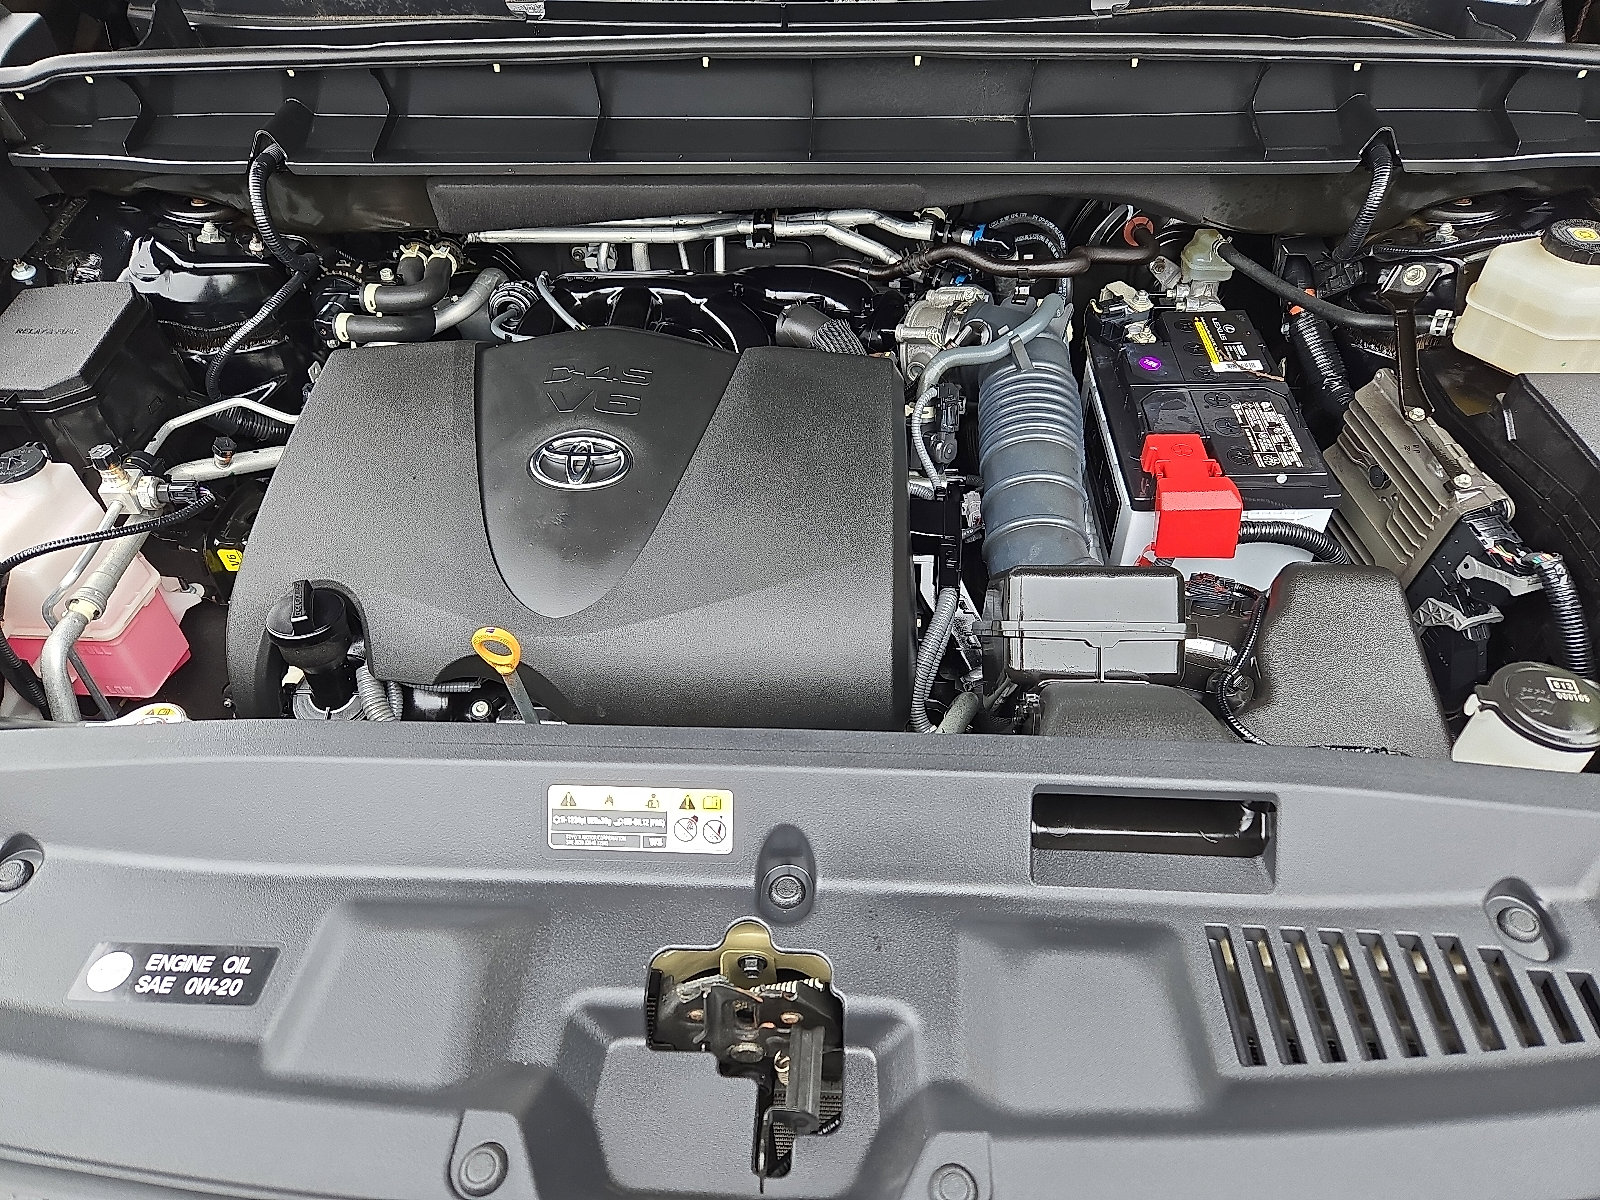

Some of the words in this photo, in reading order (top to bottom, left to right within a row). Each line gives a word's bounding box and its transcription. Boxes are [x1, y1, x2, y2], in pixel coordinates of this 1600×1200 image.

[1211, 317, 1228, 341] LEXUS
[546, 389, 641, 416] V6
[144, 953, 216, 974] ENGINE
[222, 955, 252, 975] OIL
[134, 975, 177, 995] SAE
[184, 976, 244, 997] 0W-20
